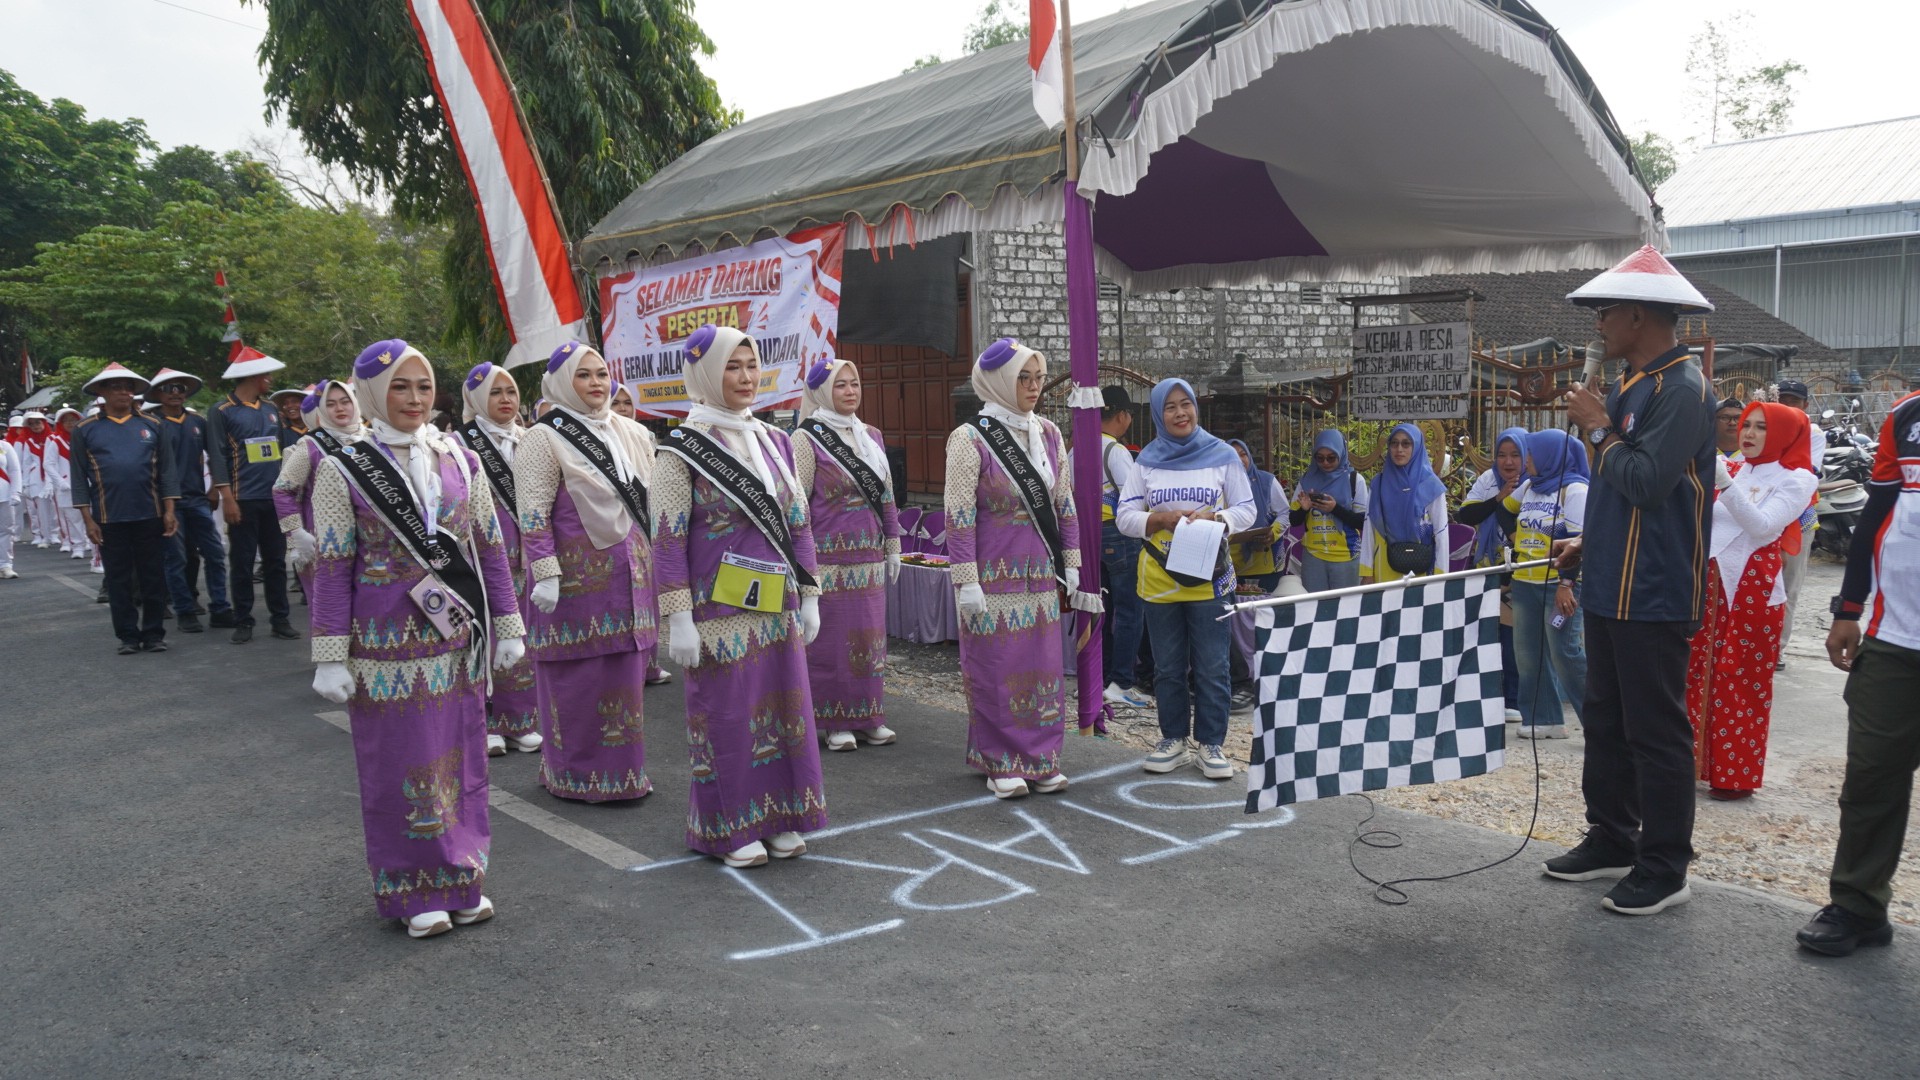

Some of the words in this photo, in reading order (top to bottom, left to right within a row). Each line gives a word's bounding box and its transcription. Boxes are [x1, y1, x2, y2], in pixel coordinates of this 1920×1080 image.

[637, 269, 711, 318] SELAMAT
[710, 257, 782, 299] DATANG
[667, 305, 739, 339] PESERTA
[1365, 330, 1413, 354] KEPALA
[1419, 328, 1454, 351] DESA
[624, 354, 654, 380] GERAK
[643, 387, 664, 399] TINGKAT
[471, 437, 485, 450] Ibu
[480, 449, 502, 473] Kades
[561, 423, 580, 436] Ibu
[578, 435, 607, 461] Kades
[820, 432, 835, 447] Ibu
[834, 446, 860, 469] Kades
[990, 428, 1007, 446] Ibu
[1002, 445, 1027, 475] Kades
[354, 452, 375, 472] Ibu
[366, 469, 401, 505] Kades
[683, 434, 702, 453] Ibu
[701, 451, 740, 482] Camat
[736, 476, 784, 543] Kedungadem
[743, 580, 760, 608] A
